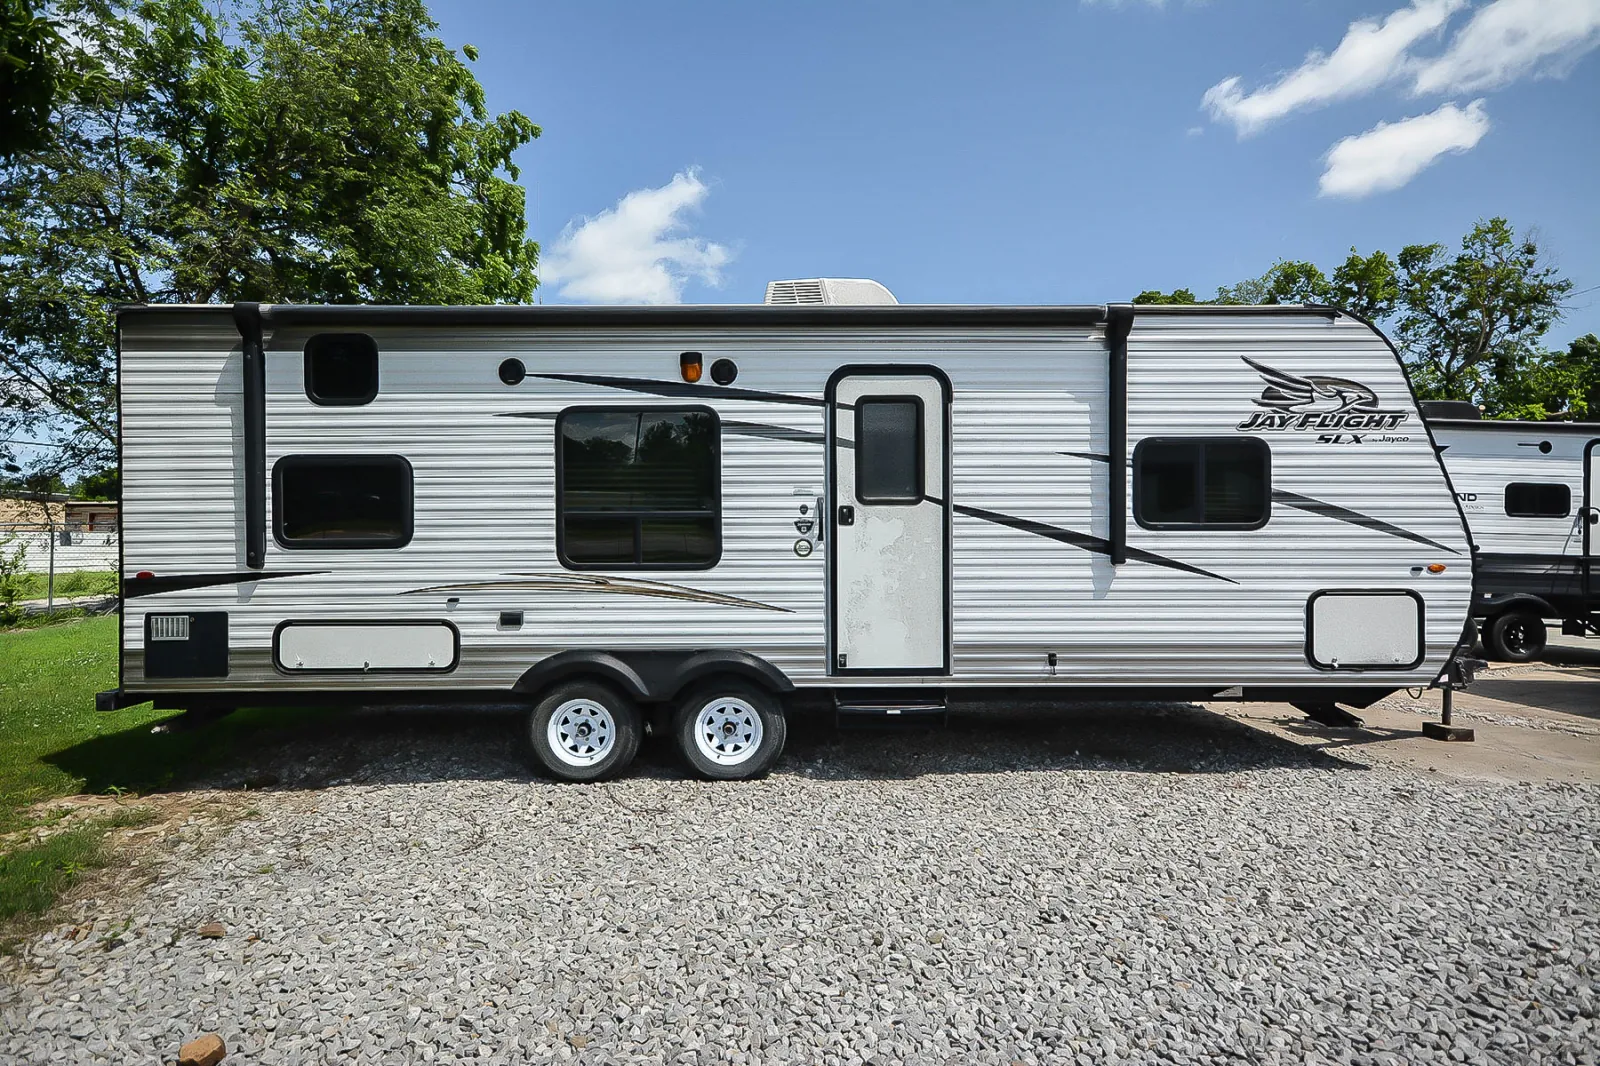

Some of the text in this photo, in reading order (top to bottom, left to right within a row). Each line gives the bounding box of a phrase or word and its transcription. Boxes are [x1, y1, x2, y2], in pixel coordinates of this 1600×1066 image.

[1237, 412, 1409, 431] JAY FLIGHT
[1315, 434, 1367, 444] SLX
[1378, 435, 1409, 443] Jayco
